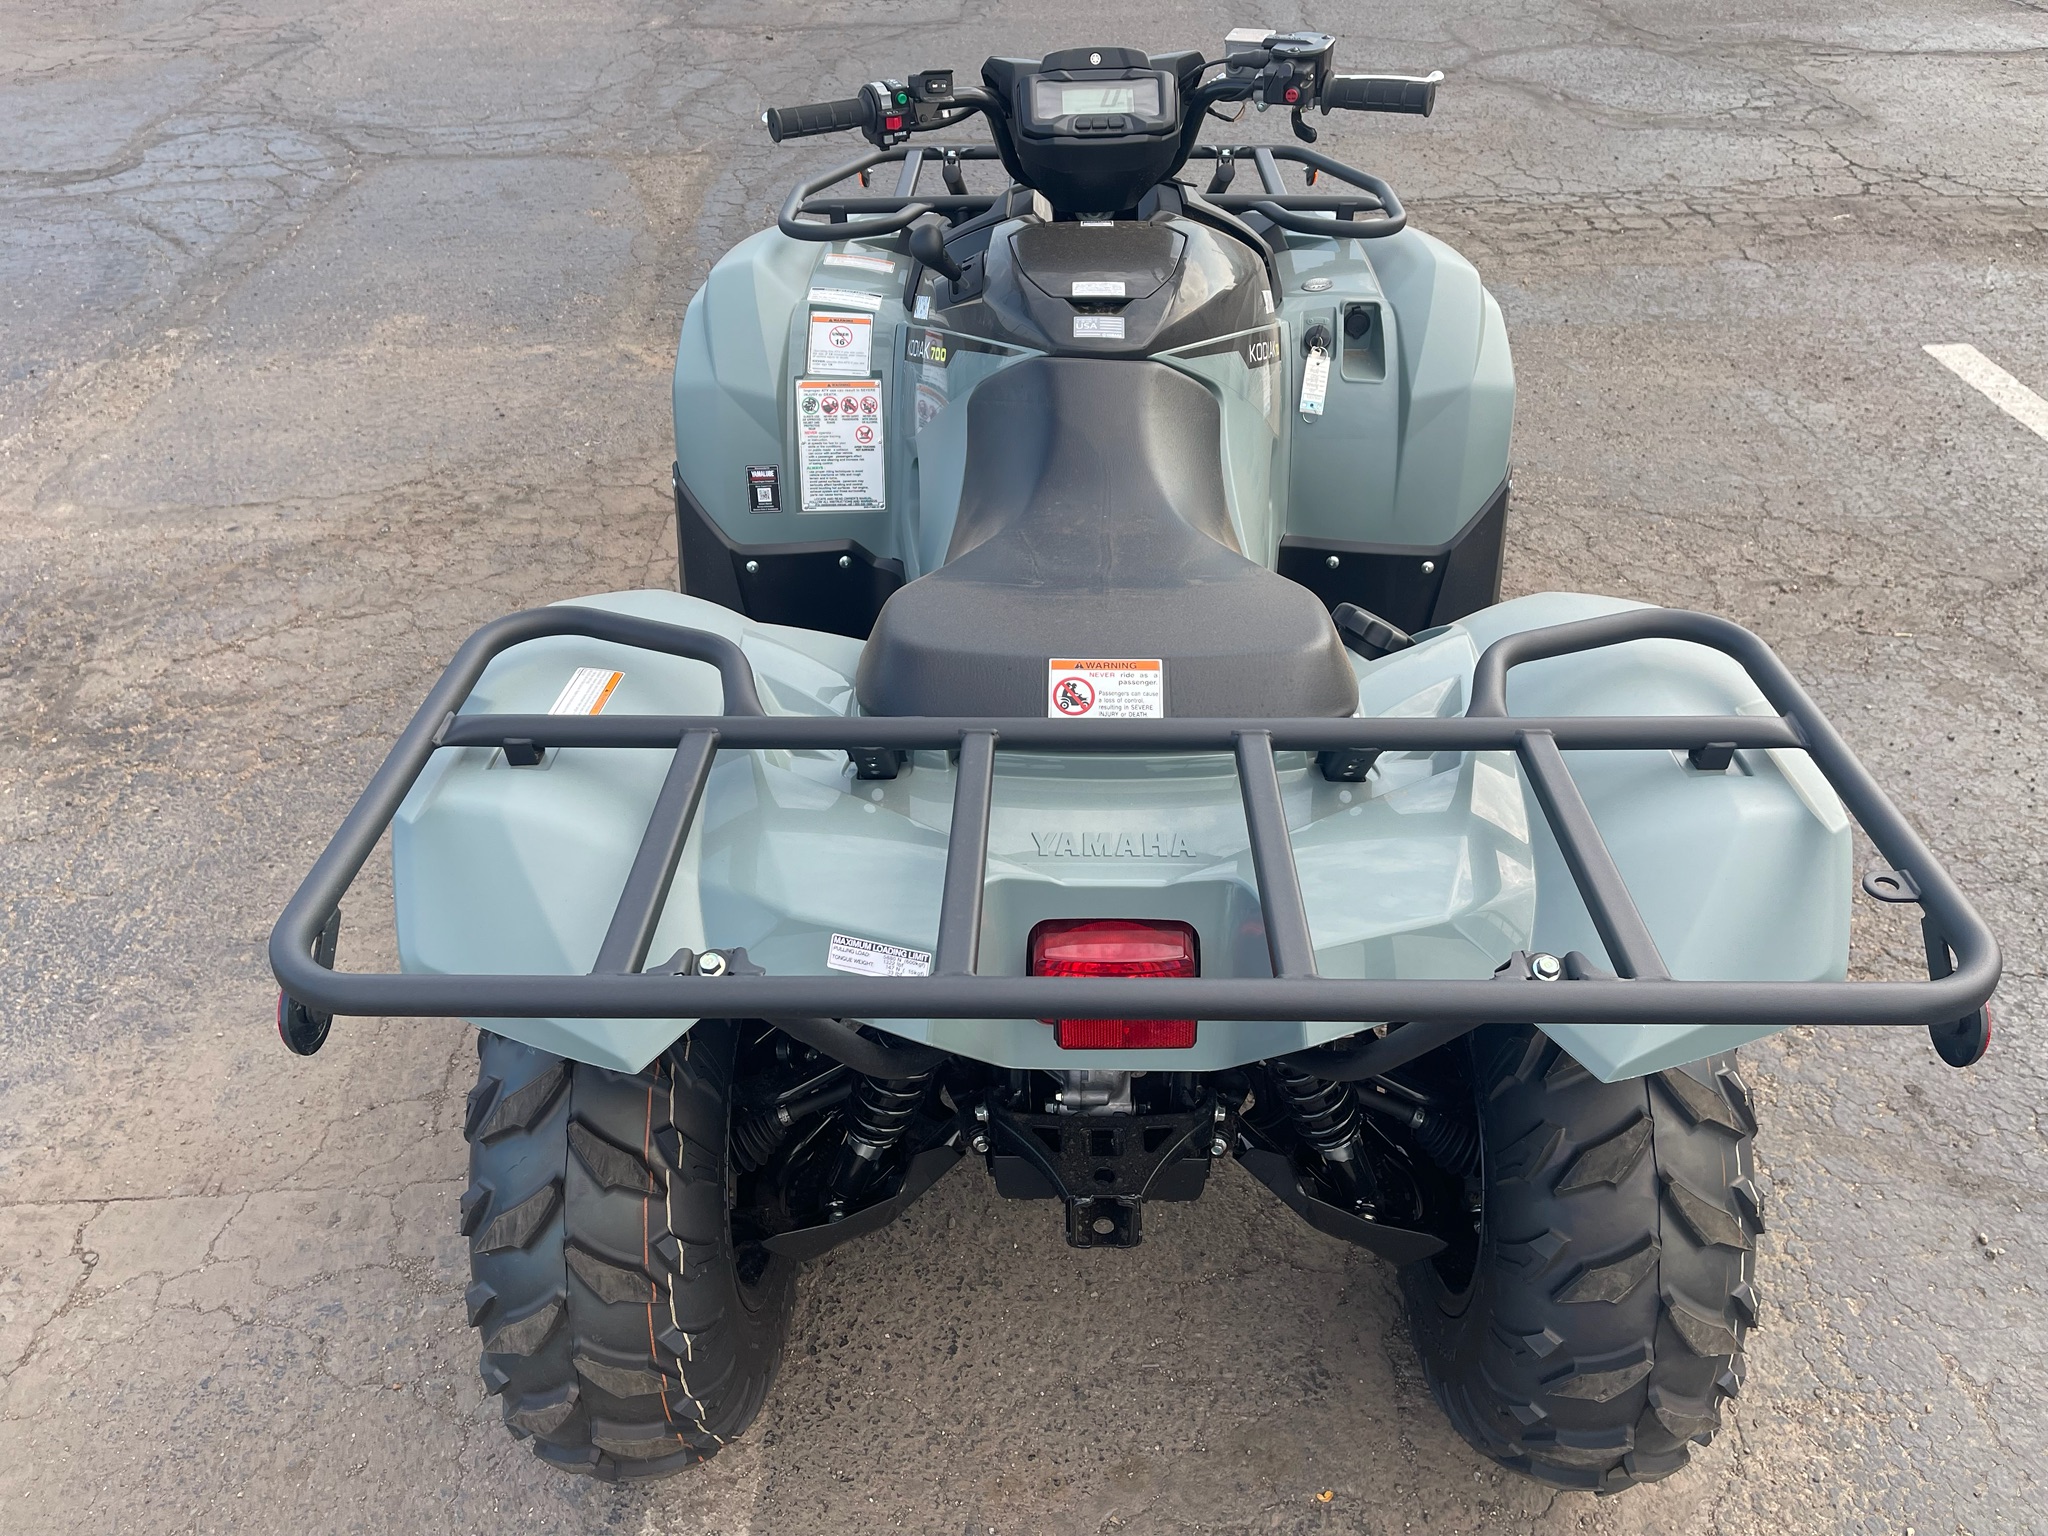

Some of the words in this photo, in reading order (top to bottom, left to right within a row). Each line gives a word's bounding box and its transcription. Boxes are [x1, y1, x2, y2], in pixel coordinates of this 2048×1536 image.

[931, 347, 946, 361] 700
[1031, 832, 1196, 857] YAMAHA
[833, 936, 871, 951] MAXIMUM
[872, 944, 907, 958] LOADING
[908, 952, 929, 962] LIMIT
[834, 946, 854, 954] PULLING
